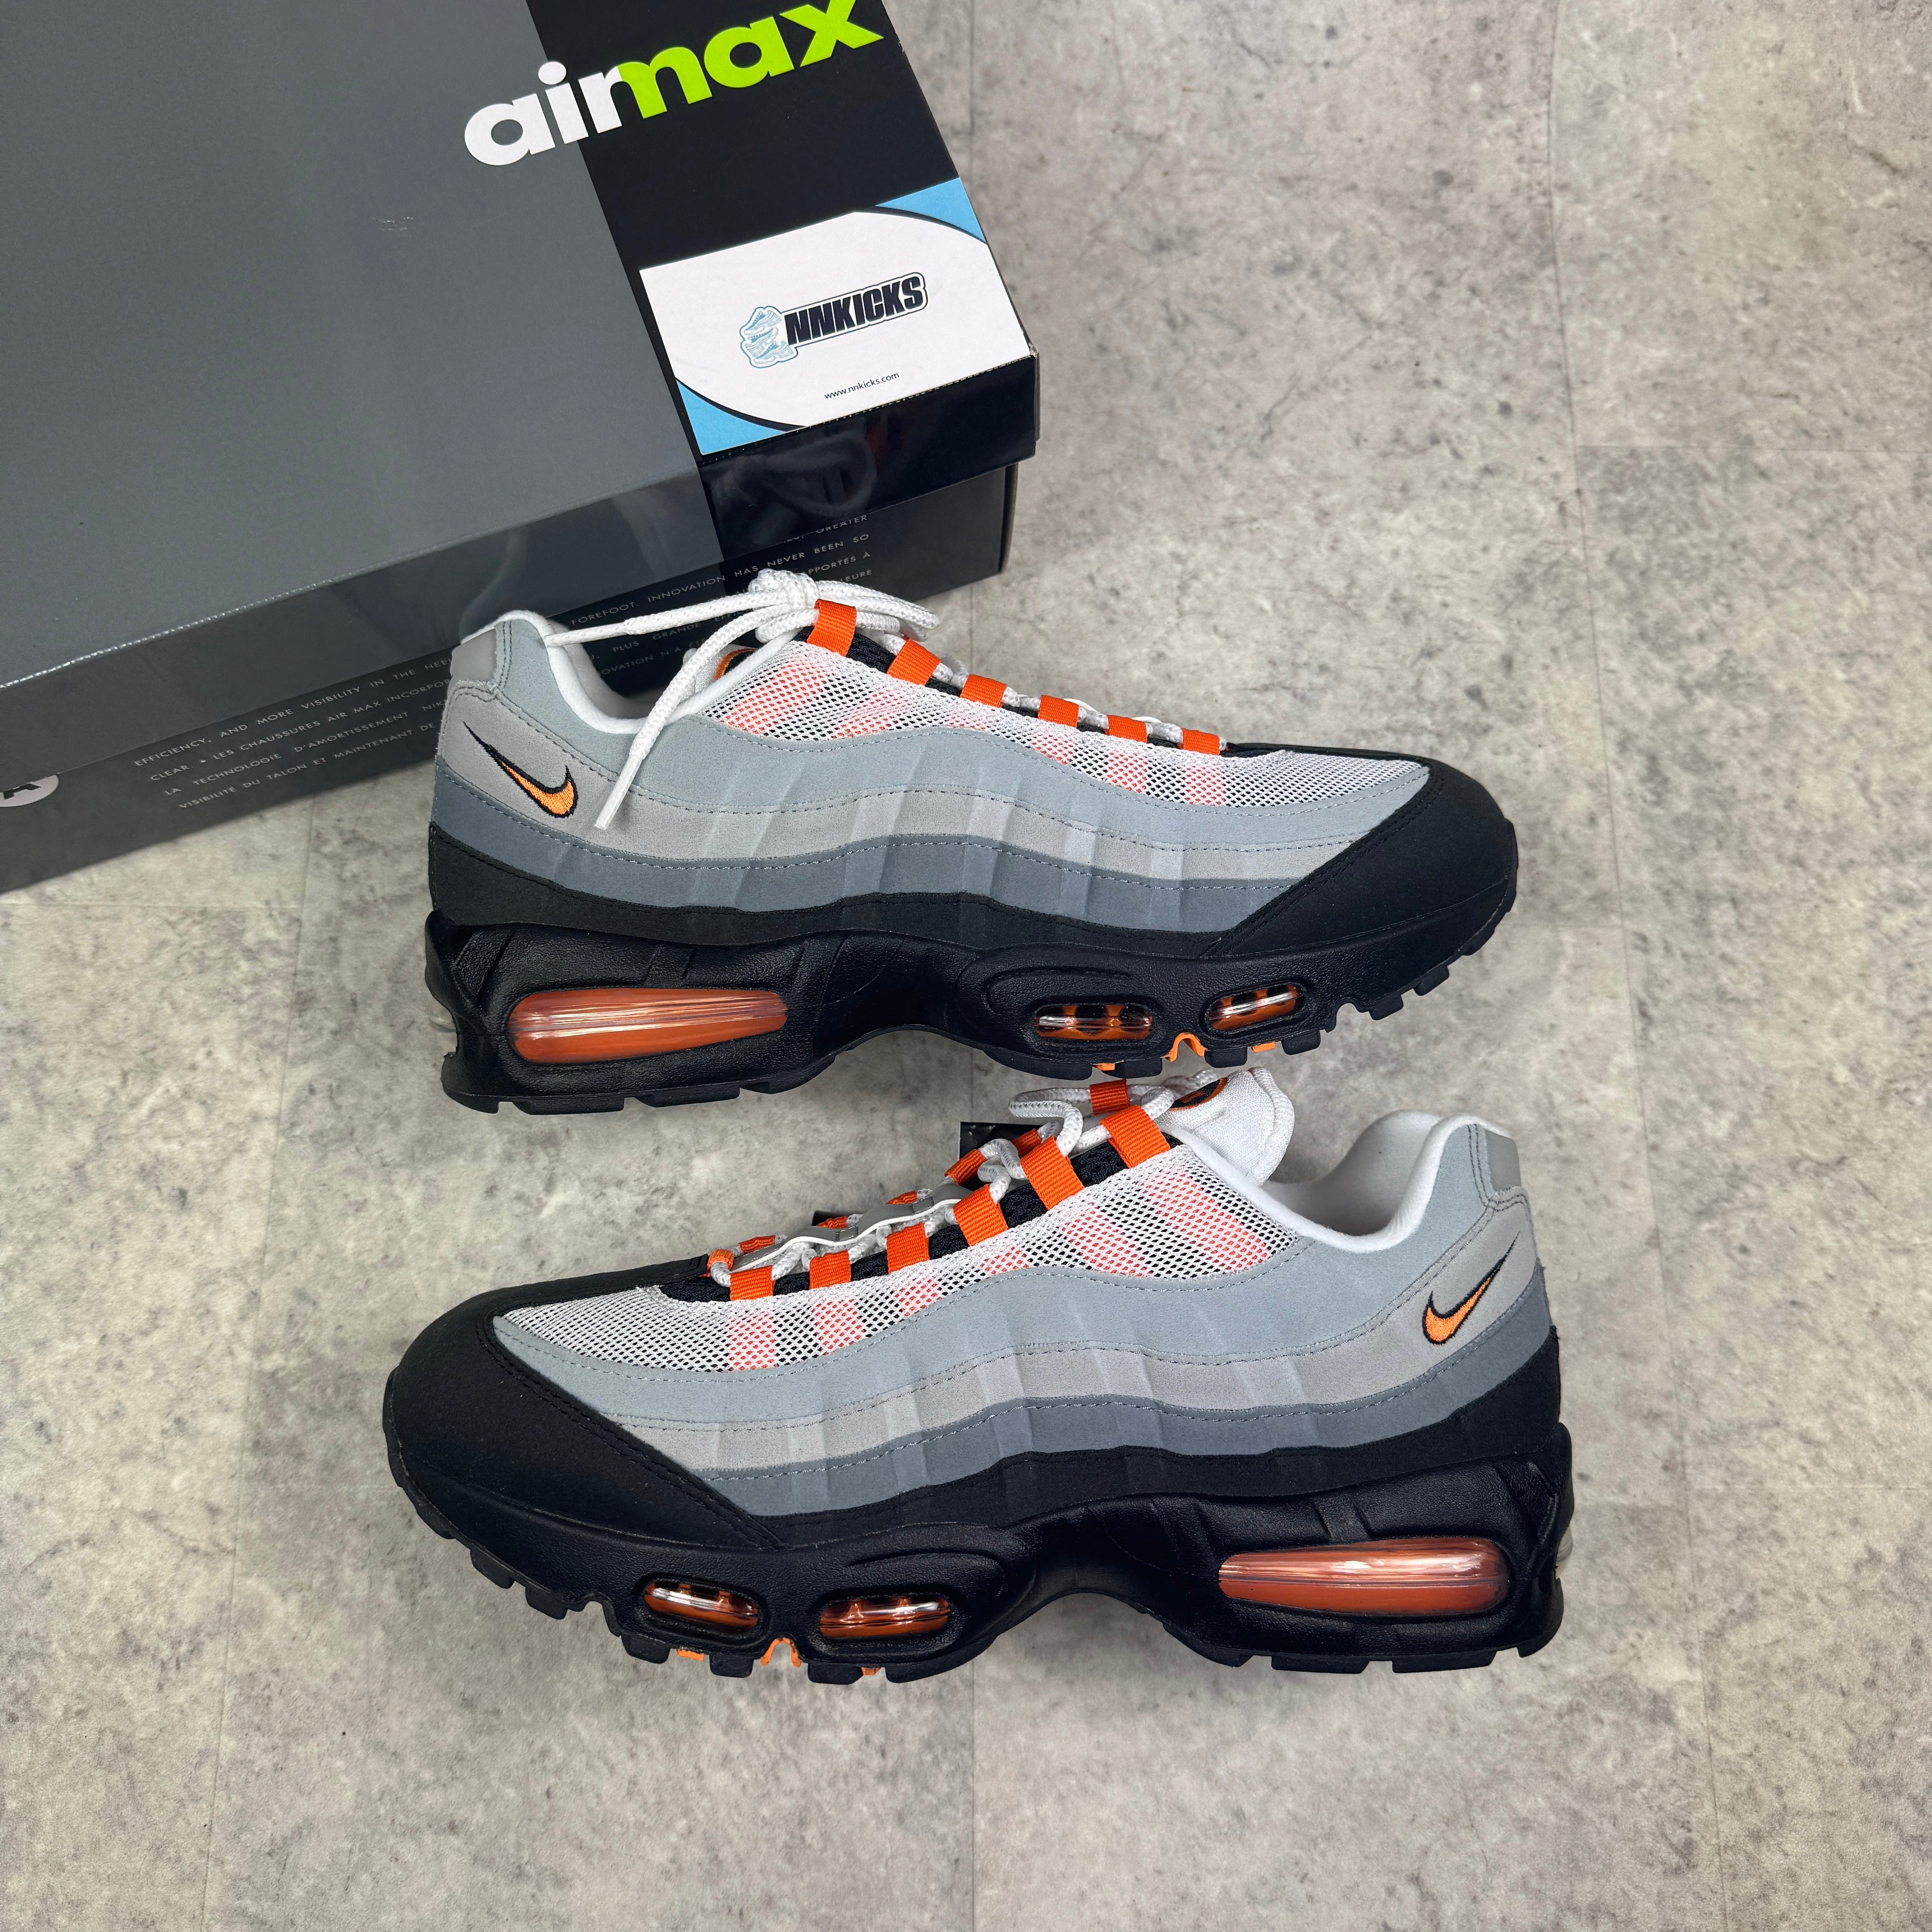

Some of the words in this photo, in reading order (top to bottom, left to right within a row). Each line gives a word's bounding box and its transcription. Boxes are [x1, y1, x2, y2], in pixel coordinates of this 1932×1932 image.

[465, 0, 884, 166] airmax
[784, 276, 924, 345] NNKICKS
[824, 373, 899, 399] www.nnkicks.com
[221, 724, 248, 737] AND
[257, 708, 294, 725] MORE
[301, 686, 360, 709] VISIBILITY
[370, 679, 385, 688] IN
[393, 669, 416, 681] THE
[648, 575, 725, 603] INNOVATION
[734, 566, 758, 578] HAS
[768, 552, 805, 568] NEVER
[814, 541, 844, 554] BEEN
[853, 534, 869, 543] SO
[193, 753, 282, 786] TECHNOLOGIE
[294, 711, 408, 753] D'AMORTISSEMENT
[613, 640, 639, 653] PLUS
[653, 622, 701, 640] GRANDE
[213, 750, 234, 760] LES
[240, 721, 321, 750] CHAUSSURES
[328, 712, 348, 722] AIR
[354, 701, 381, 713] MAX
[179, 786, 237, 808] VISIBILITÉ
[242, 779, 260, 788] DU
[267, 764, 306, 780] TALON
[334, 729, 412, 759] MAINTENANT
[420, 722, 436, 731] DE
